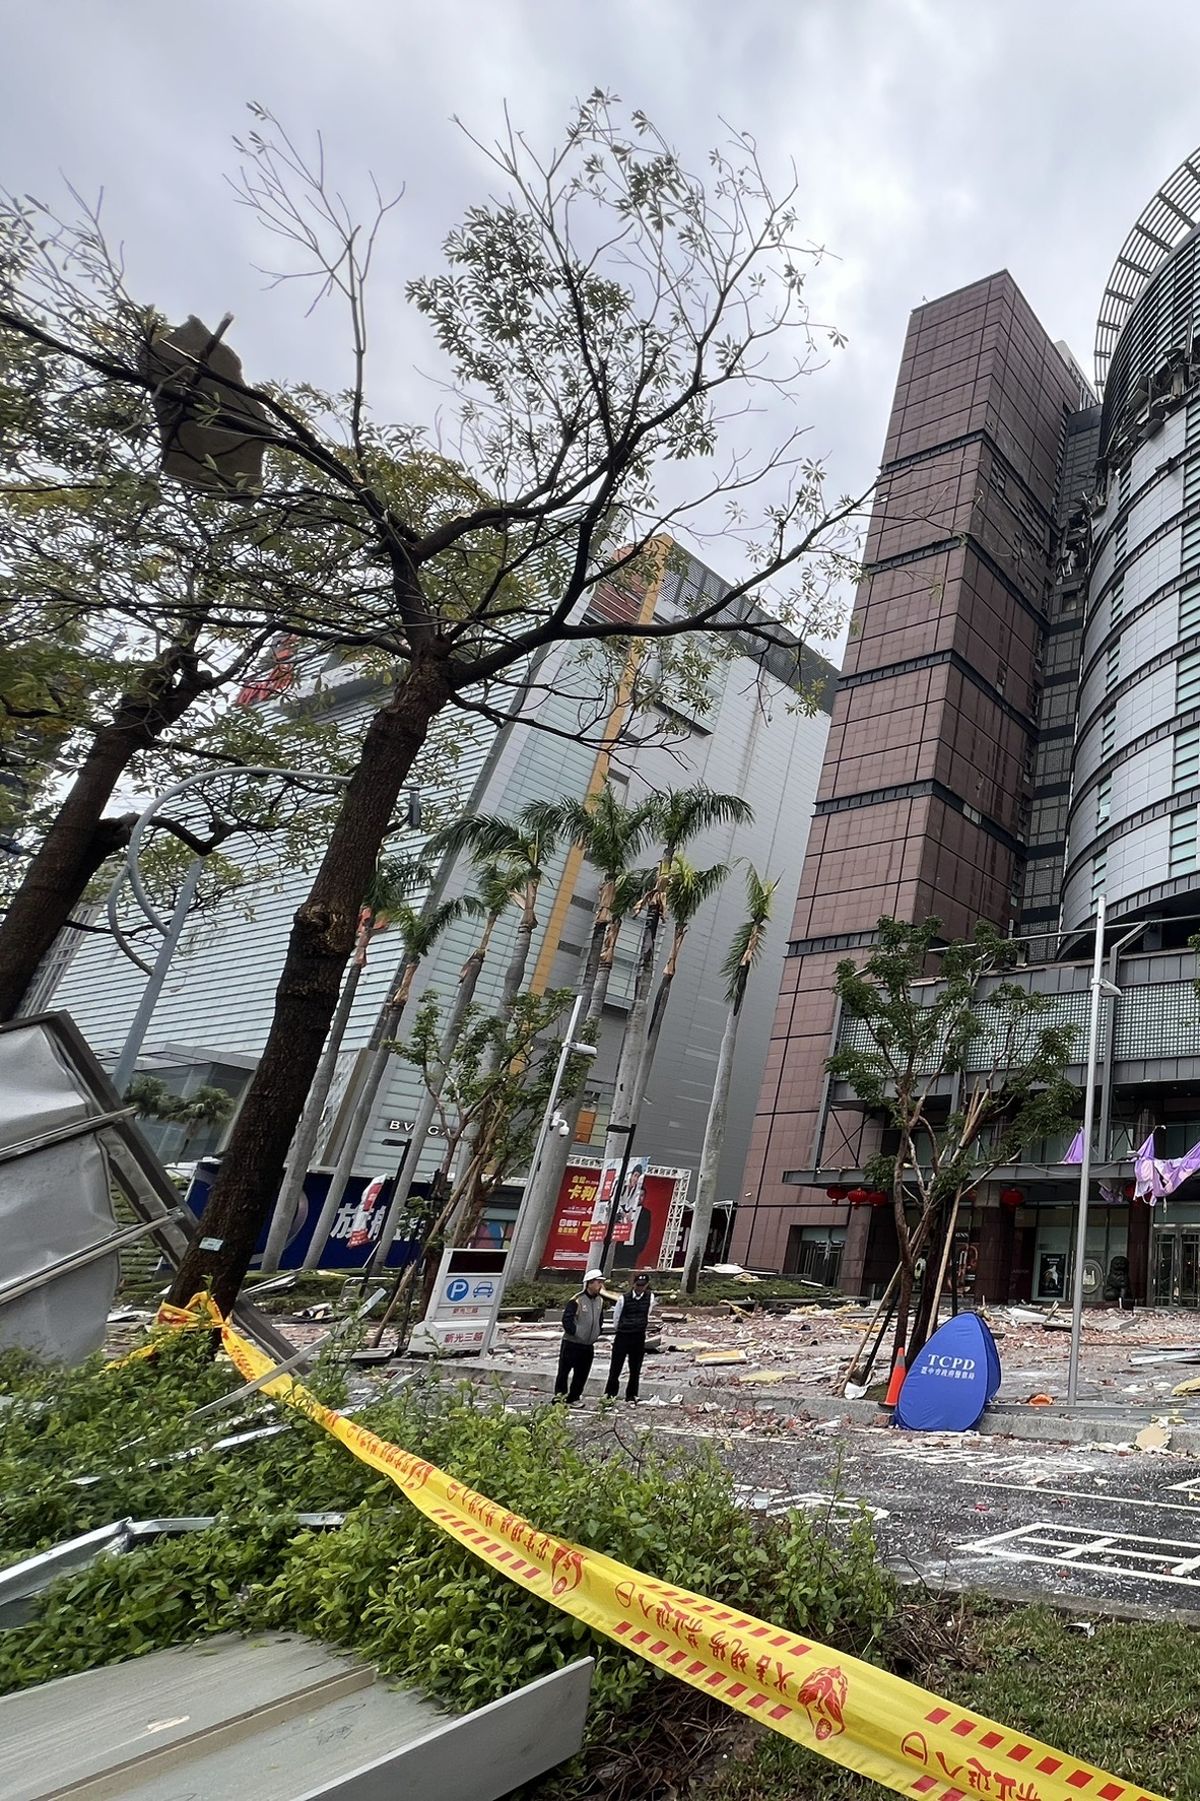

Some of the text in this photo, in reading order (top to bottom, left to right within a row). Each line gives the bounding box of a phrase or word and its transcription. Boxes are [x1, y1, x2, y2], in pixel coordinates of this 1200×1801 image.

[444, 1332, 484, 1343] 新光三越
[928, 1353, 975, 1370] TCPD
